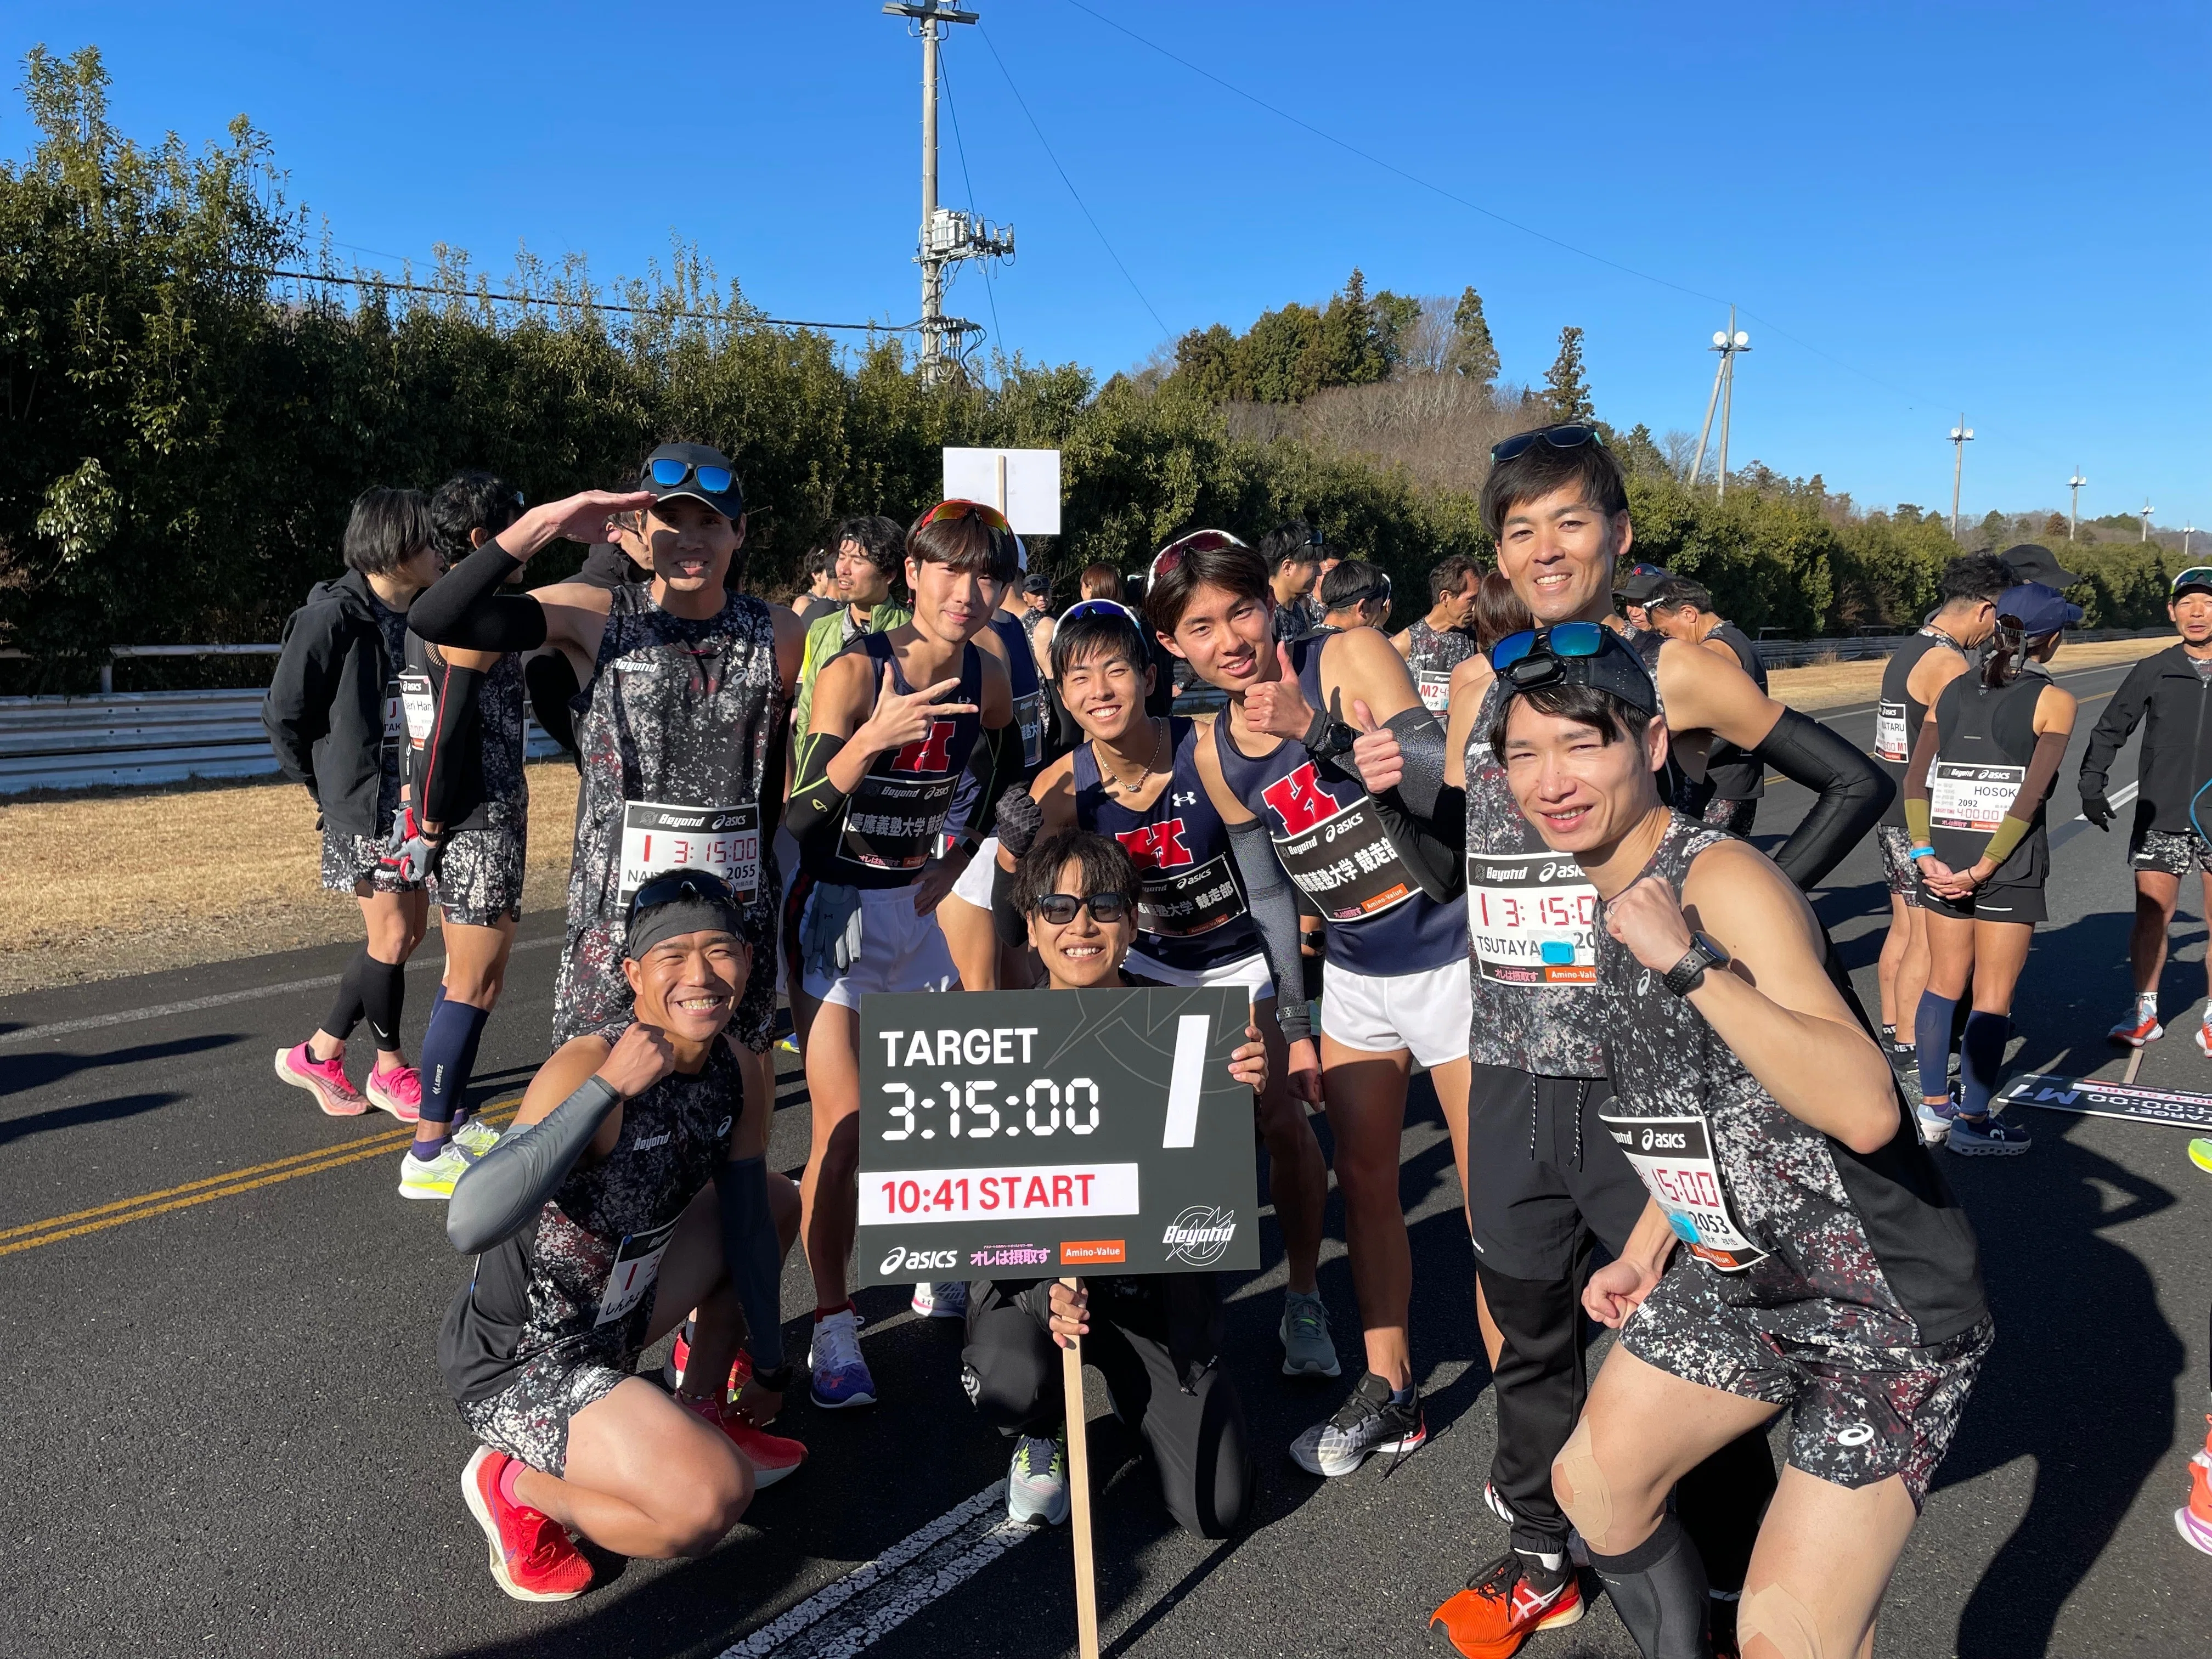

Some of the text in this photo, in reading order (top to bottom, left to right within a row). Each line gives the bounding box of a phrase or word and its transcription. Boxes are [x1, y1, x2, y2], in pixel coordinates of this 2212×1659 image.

[1420, 684, 1438, 697] M2
[390, 701, 397, 718] J
[1950, 768, 1975, 777] Beyond
[881, 786, 921, 798] Beyond
[1974, 786, 2017, 798] HOSOK
[1958, 799, 1978, 808] 2092
[658, 814, 706, 827] Beyond
[848, 812, 926, 837] 慶應義塾大学
[644, 834, 757, 864] 1 3:15:00
[1288, 836, 1318, 856] Beyond
[726, 864, 755, 880] 2055
[1293, 858, 1358, 893] 慶應義塾大学
[1486, 865, 1586, 882] Beyond asic
[1195, 881, 1234, 910] 競走部
[1366, 888, 1404, 910] Amino-Value
[1481, 893, 1489, 927] 1
[1191, 917, 1225, 934] Amino-Value
[1477, 935, 1541, 956] TSUTAYA
[879, 1028, 1039, 1068] TARGET
[2094, 1086, 2159, 1098] START
[881, 1077, 1099, 1141] 3:15:00
[633, 1131, 671, 1152] Beyond
[881, 1174, 1096, 1215] 10:41 START
[1688, 1210, 1730, 1234] 2053
[1162, 1223, 1237, 1246] Beyond
[969, 1248, 1051, 1267] オレは摂取す
[1065, 1246, 1120, 1257] Amino-Value
